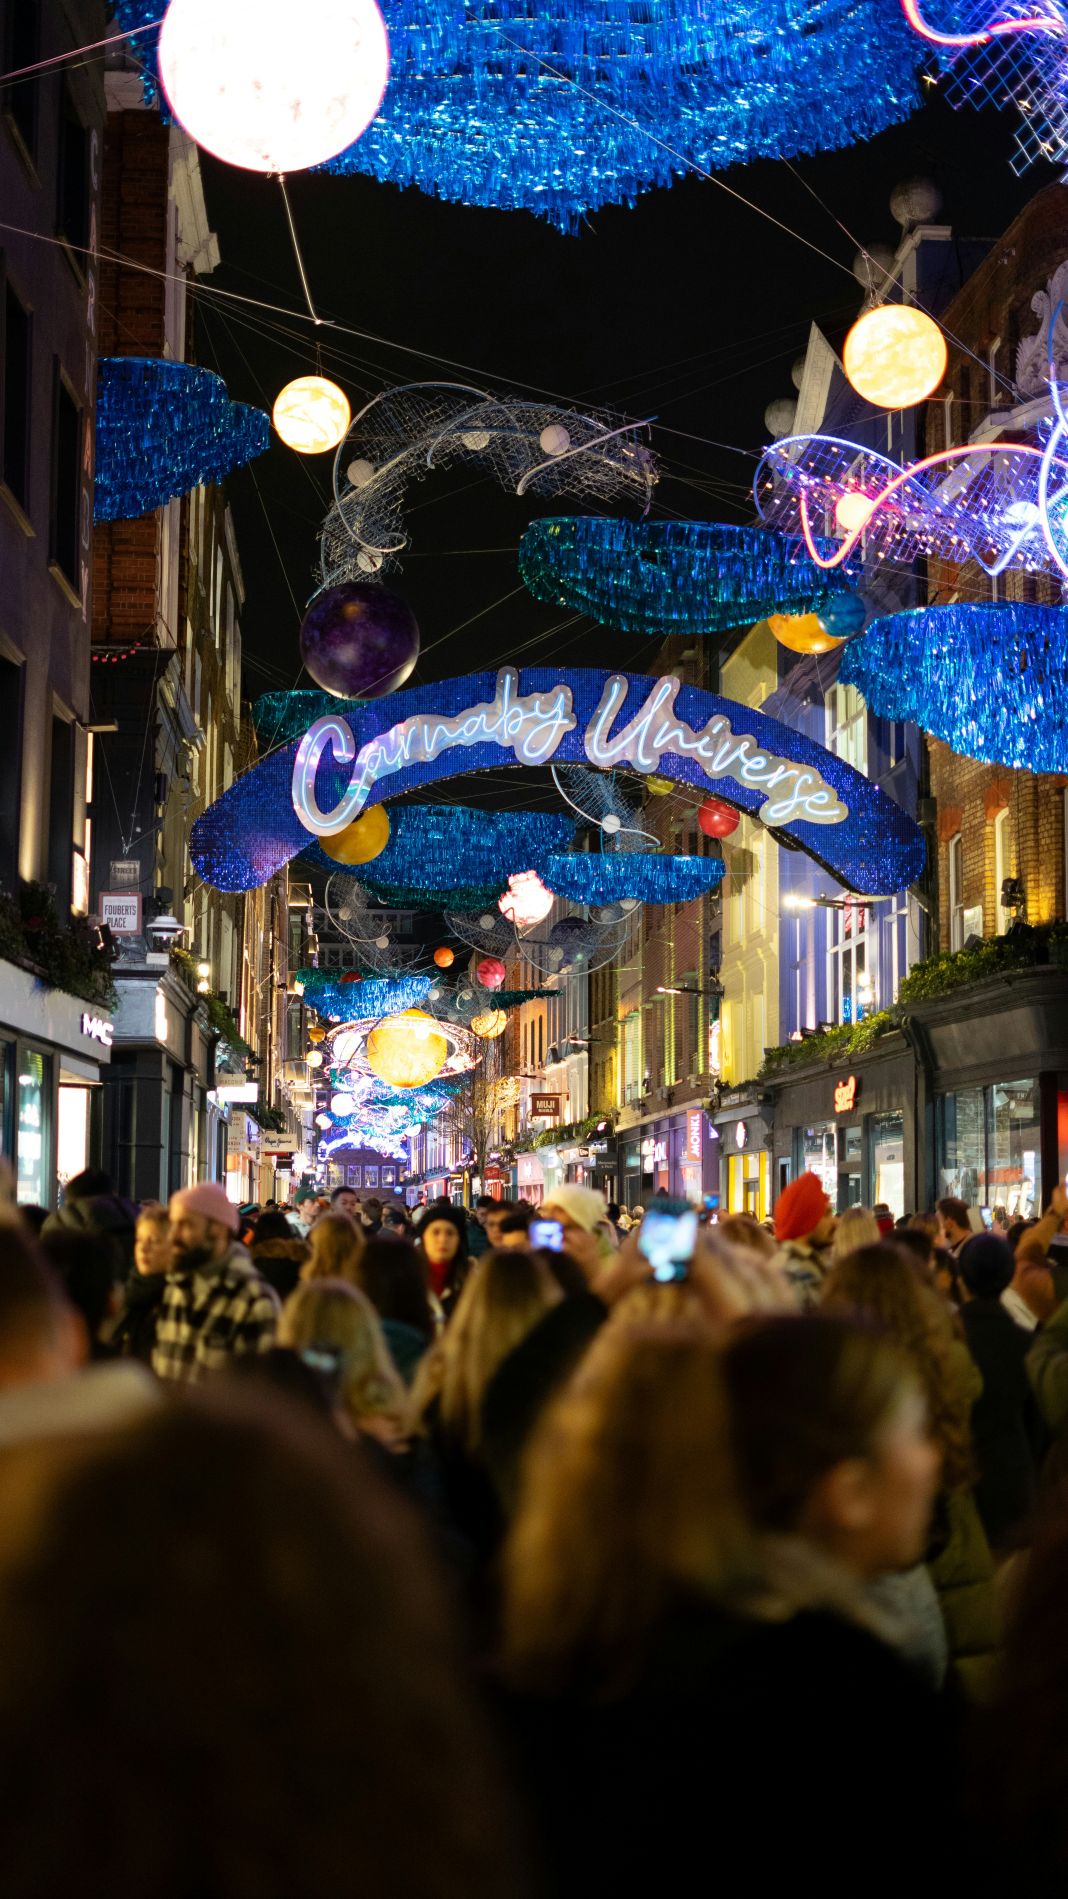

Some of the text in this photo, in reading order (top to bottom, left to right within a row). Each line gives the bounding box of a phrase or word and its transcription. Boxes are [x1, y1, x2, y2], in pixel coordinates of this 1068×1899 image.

[293, 667, 848, 835] Carnaby Universe
[104, 904, 137, 916] FOUBERT'S
[106, 917, 127, 928] PLACE
[536, 1100, 555, 1109] MUJI
